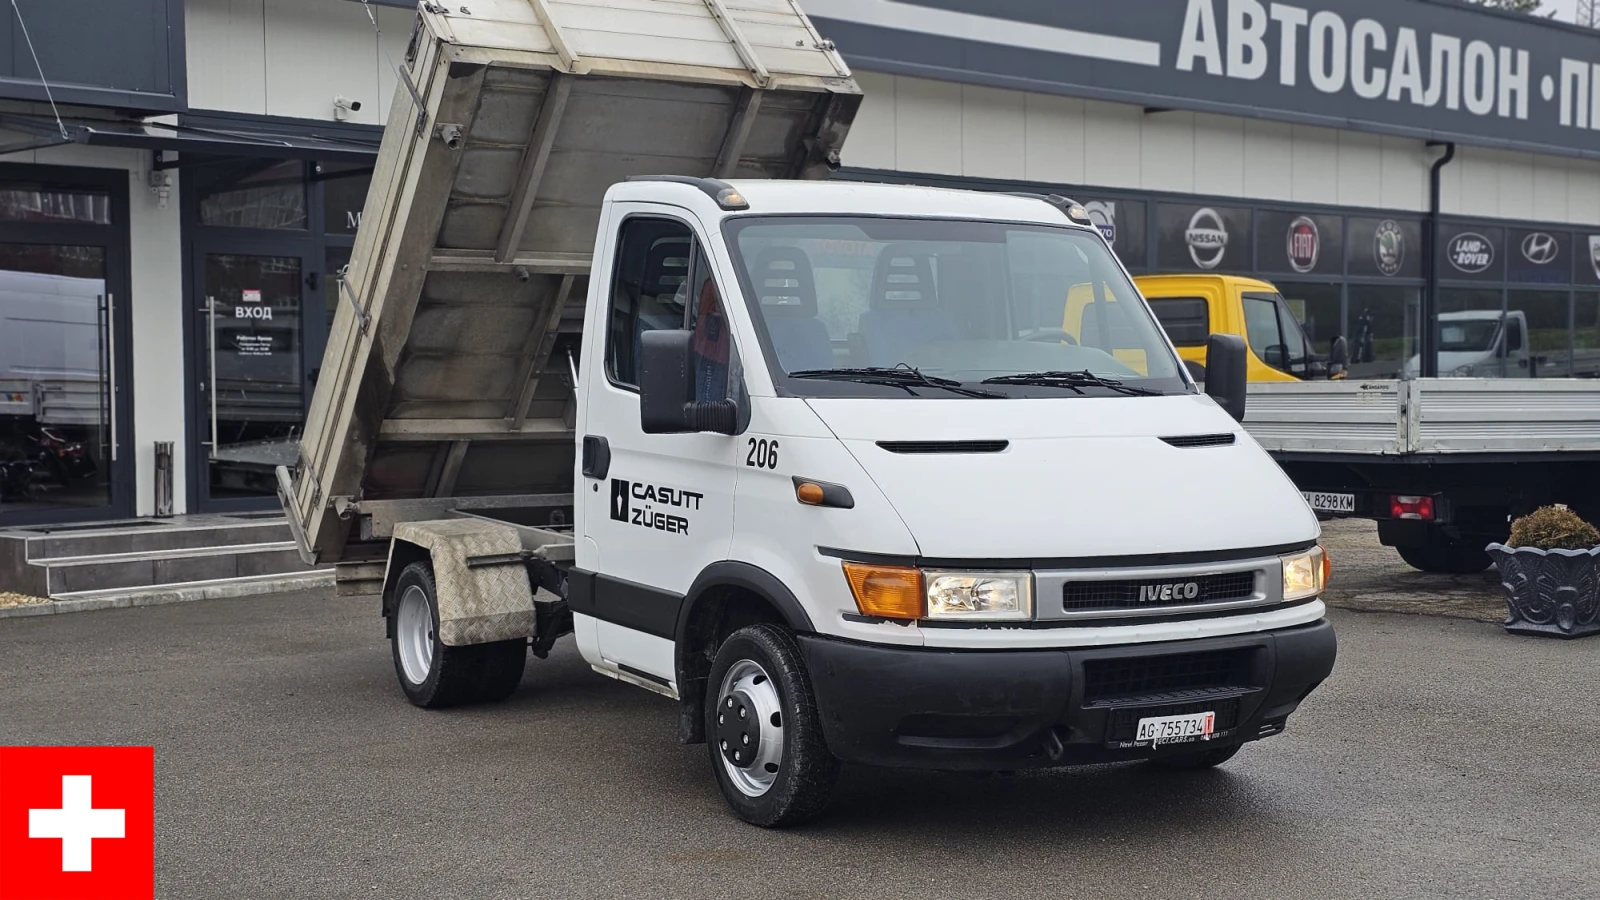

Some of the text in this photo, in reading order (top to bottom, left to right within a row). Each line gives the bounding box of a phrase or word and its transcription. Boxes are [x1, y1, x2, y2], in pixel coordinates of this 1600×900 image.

[1175, 0, 1530, 120] АВТОСАЛОН
[1188, 232, 1225, 245] NISSAN
[1293, 233, 1313, 259] FIAT
[235, 306, 272, 320] ВХОД
[746, 437, 779, 470] 206
[631, 482, 704, 511] CASUTT
[631, 504, 689, 536] ZÜGER
[1139, 582, 1199, 602] IVECO
